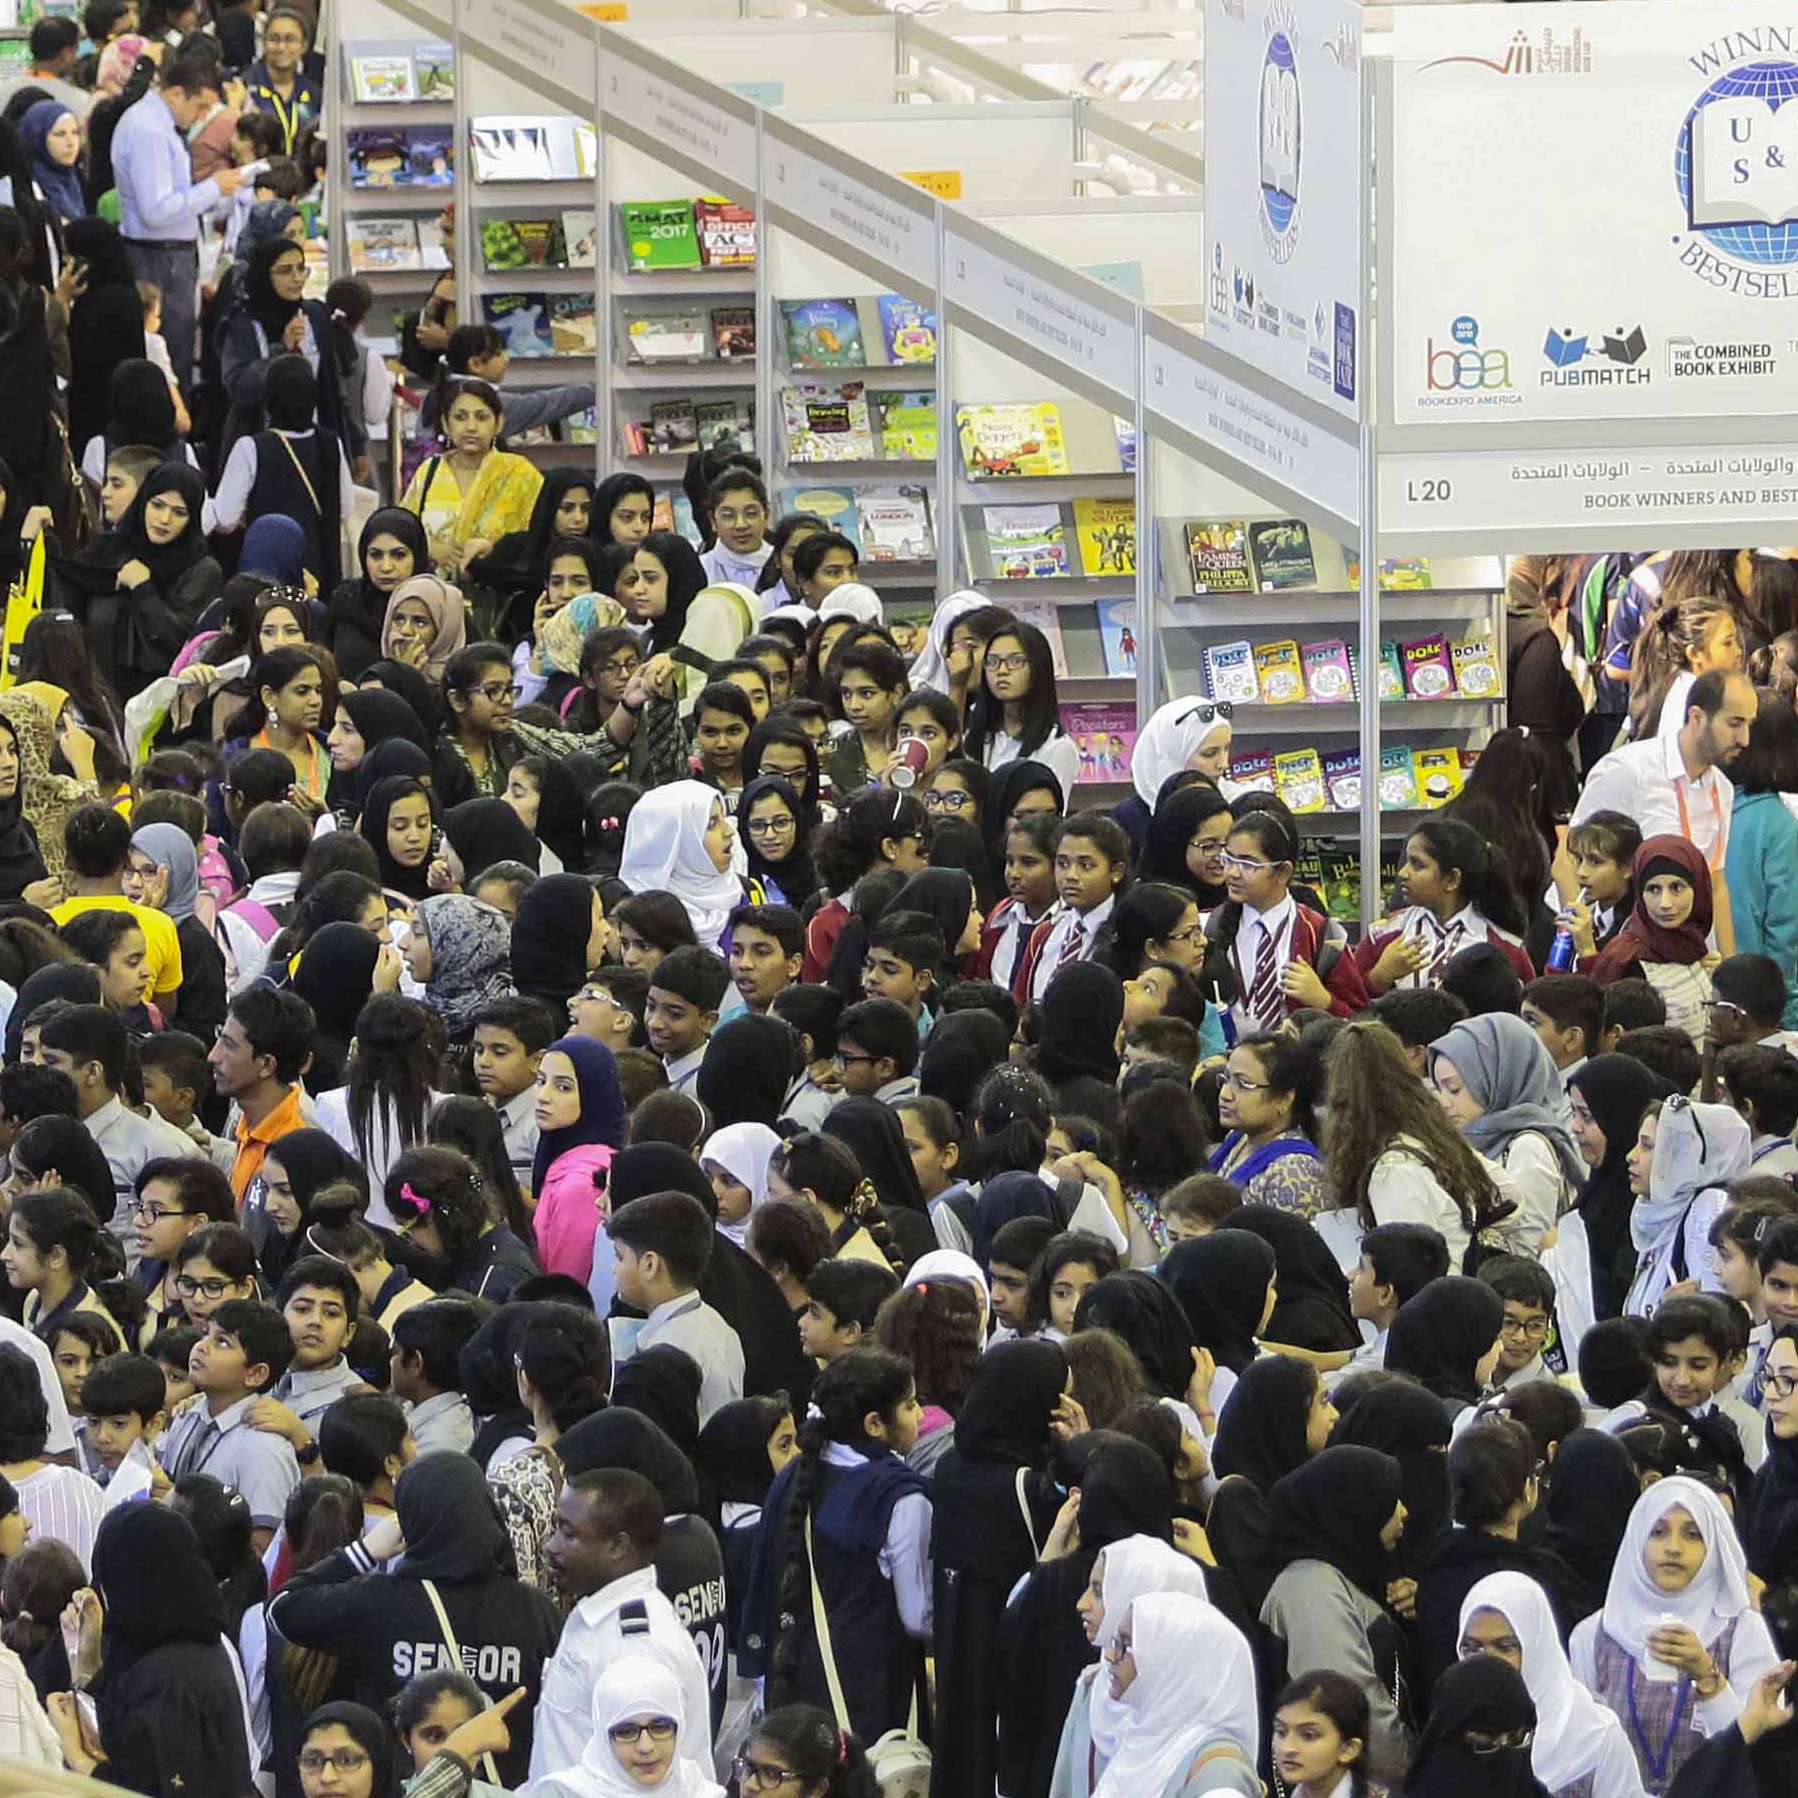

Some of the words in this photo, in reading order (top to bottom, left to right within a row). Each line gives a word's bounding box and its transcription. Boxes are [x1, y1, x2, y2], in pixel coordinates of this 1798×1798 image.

[649, 223, 690, 239] 2017
[1673, 349, 1692, 360] THE
[1694, 343, 1772, 360] COMBINED
[1426, 336, 1513, 391] bea
[1673, 362, 1715, 376] BOOK
[1718, 360, 1776, 375] EXHIBIT
[1540, 368, 1651, 388] PUBMATCH
[1417, 396, 1475, 408] BOOKEXPO
[1476, 394, 1523, 406] AMERICA
[1511, 464, 1569, 481] المتحدة
[1572, 462, 1630, 482] الولايات
[1666, 458, 1724, 476] المتحدة
[1727, 457, 1794, 476] والولايات
[1407, 479, 1451, 502] L20
[1583, 493, 1632, 509] BOOK
[1635, 491, 1715, 508] WINNERS
[1718, 490, 1757, 505] AND
[1405, 642, 1442, 661] DORK
[1380, 752, 1407, 768] ORK
